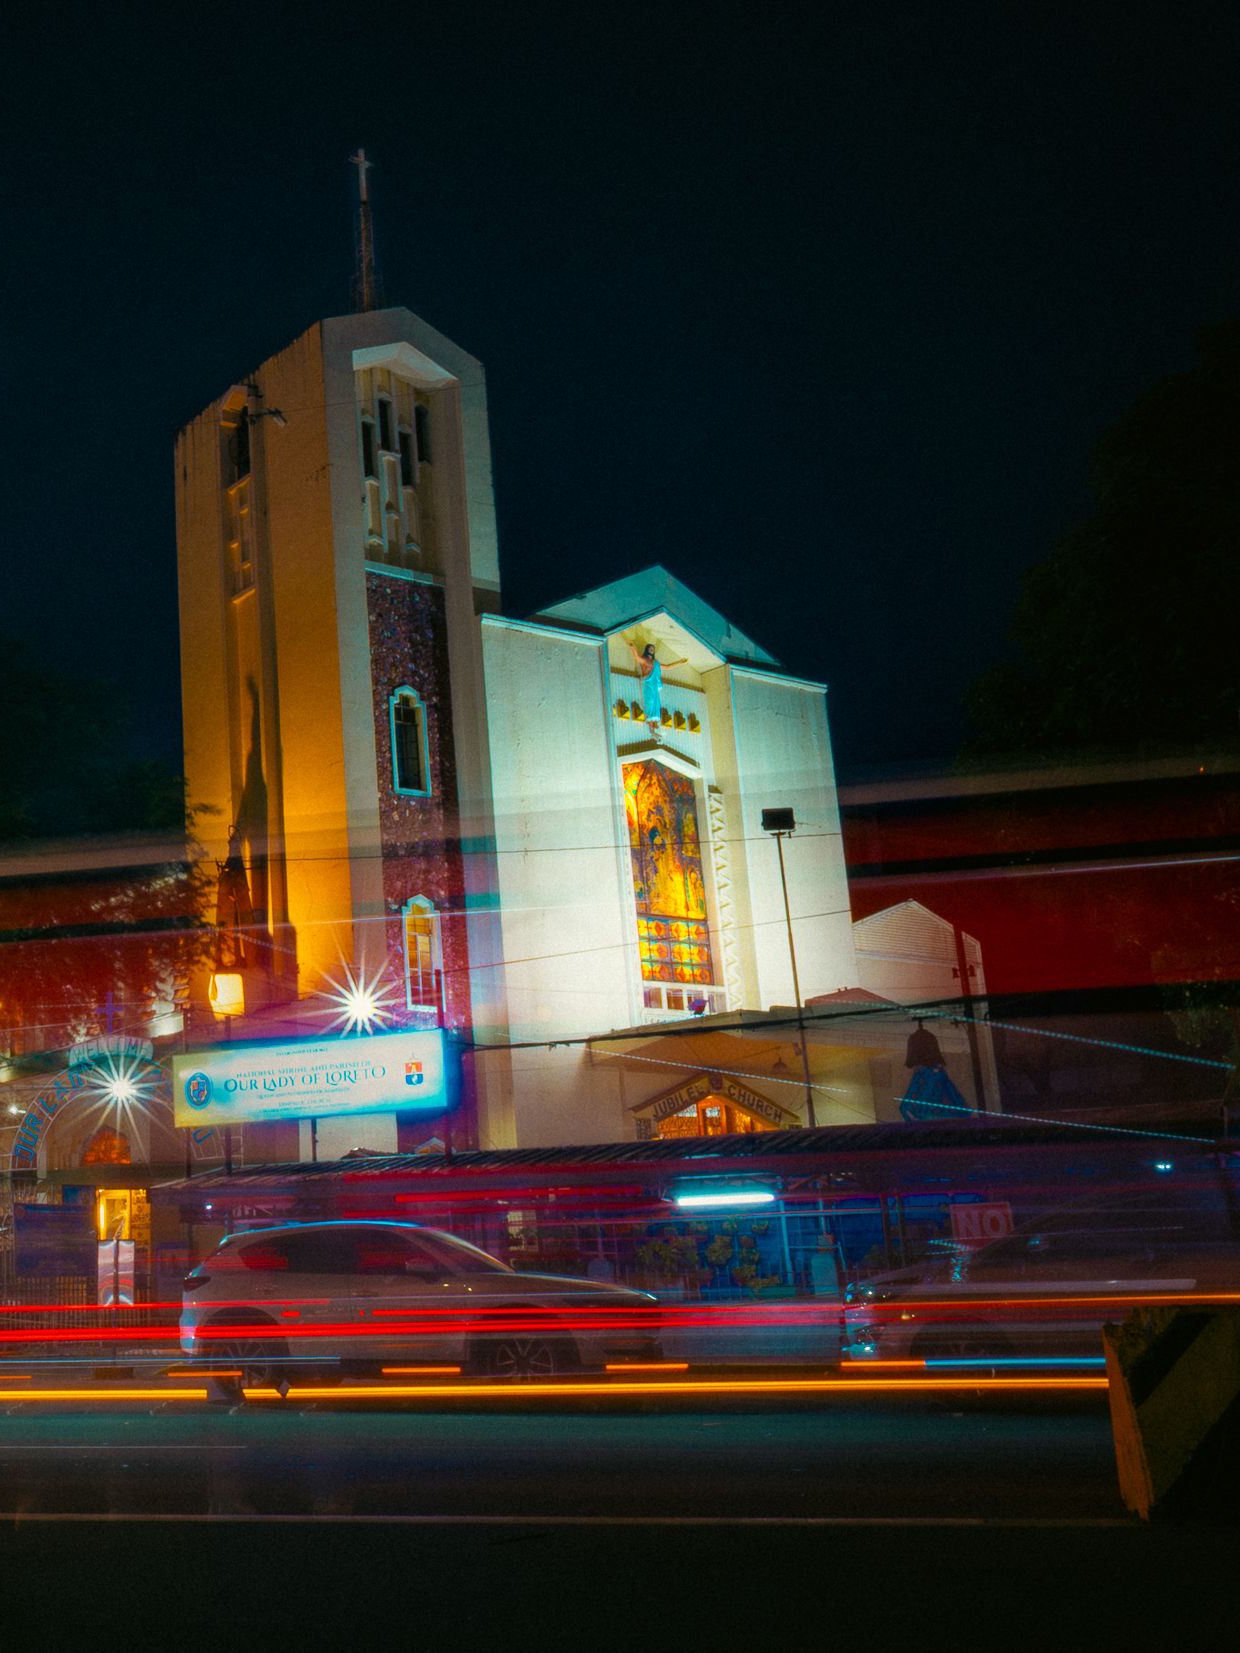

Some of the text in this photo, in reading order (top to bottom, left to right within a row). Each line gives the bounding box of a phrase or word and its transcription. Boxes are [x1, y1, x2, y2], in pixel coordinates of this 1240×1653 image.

[223, 1078, 258, 1093] OUR
[263, 1075, 297, 1092] LADY
[301, 1072, 320, 1085] OF
[326, 1064, 386, 1086] LORETO
[652, 1084, 783, 1123] JUBILEE CHURCH
[954, 1209, 1006, 1238] NO
